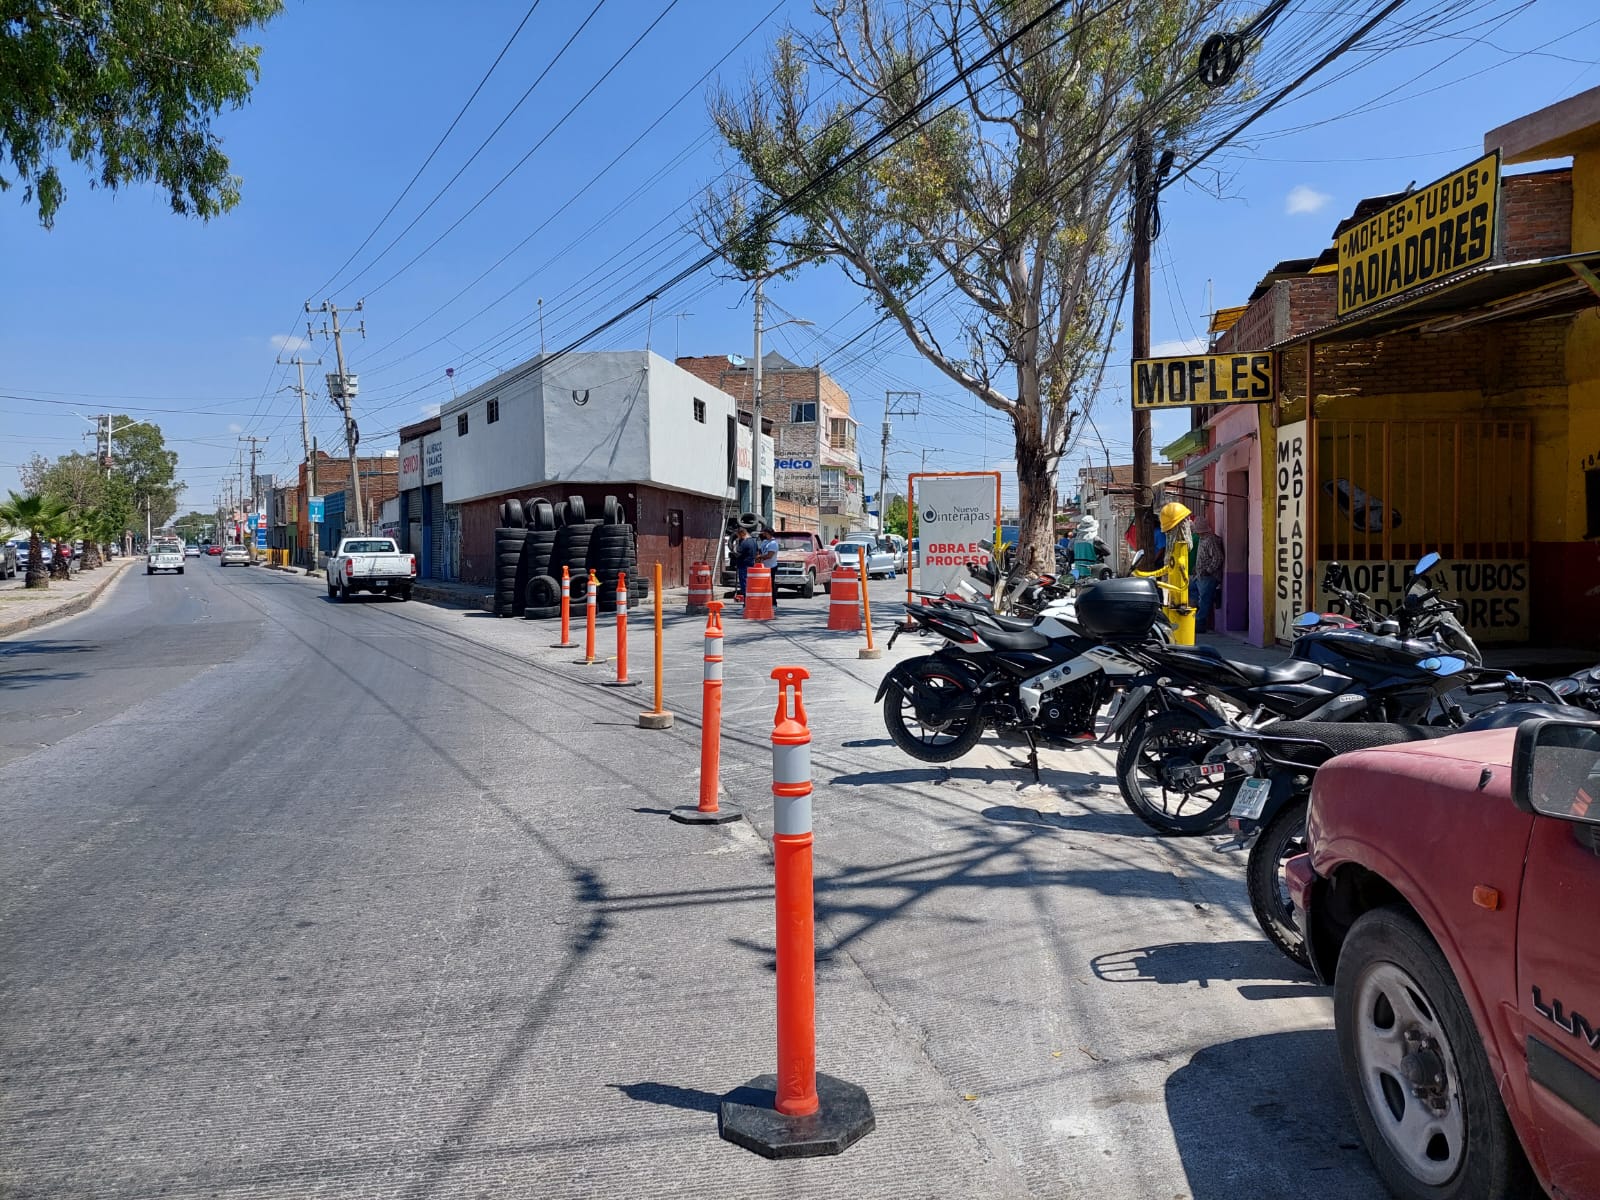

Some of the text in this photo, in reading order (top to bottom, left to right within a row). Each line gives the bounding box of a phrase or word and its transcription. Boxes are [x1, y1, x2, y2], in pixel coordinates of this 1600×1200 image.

[1348, 168, 1479, 259] MOFLES TUBOS
[1342, 202, 1489, 311] RADIADORES
[1137, 356, 1271, 404] MOFLES
[937, 511, 991, 525] interapas
[953, 505, 979, 513] Nuevo
[1277, 439, 1290, 601] MOFLES
[928, 543, 967, 554] OBRA
[1291, 436, 1304, 637] RADIADORE
[926, 554, 989, 567] PROCESO
[1451, 563, 1526, 593] TUBOS
